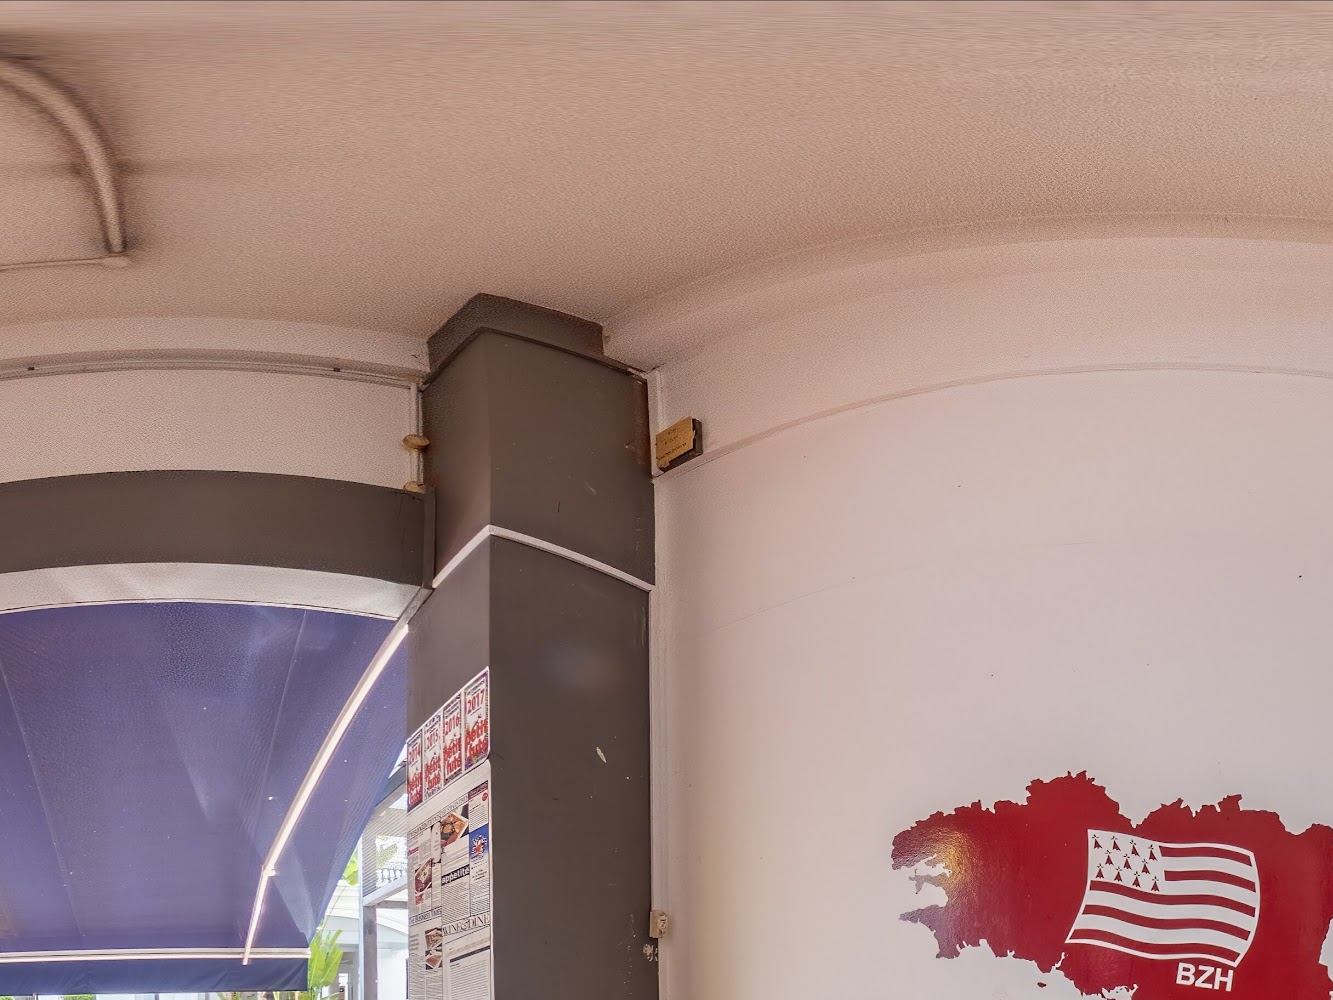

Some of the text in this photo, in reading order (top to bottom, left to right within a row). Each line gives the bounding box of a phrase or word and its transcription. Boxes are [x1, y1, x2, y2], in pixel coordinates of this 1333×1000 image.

[467, 688, 485, 714] 2017
[444, 714, 460, 736] 2016
[1176, 962, 1234, 992] BZH
